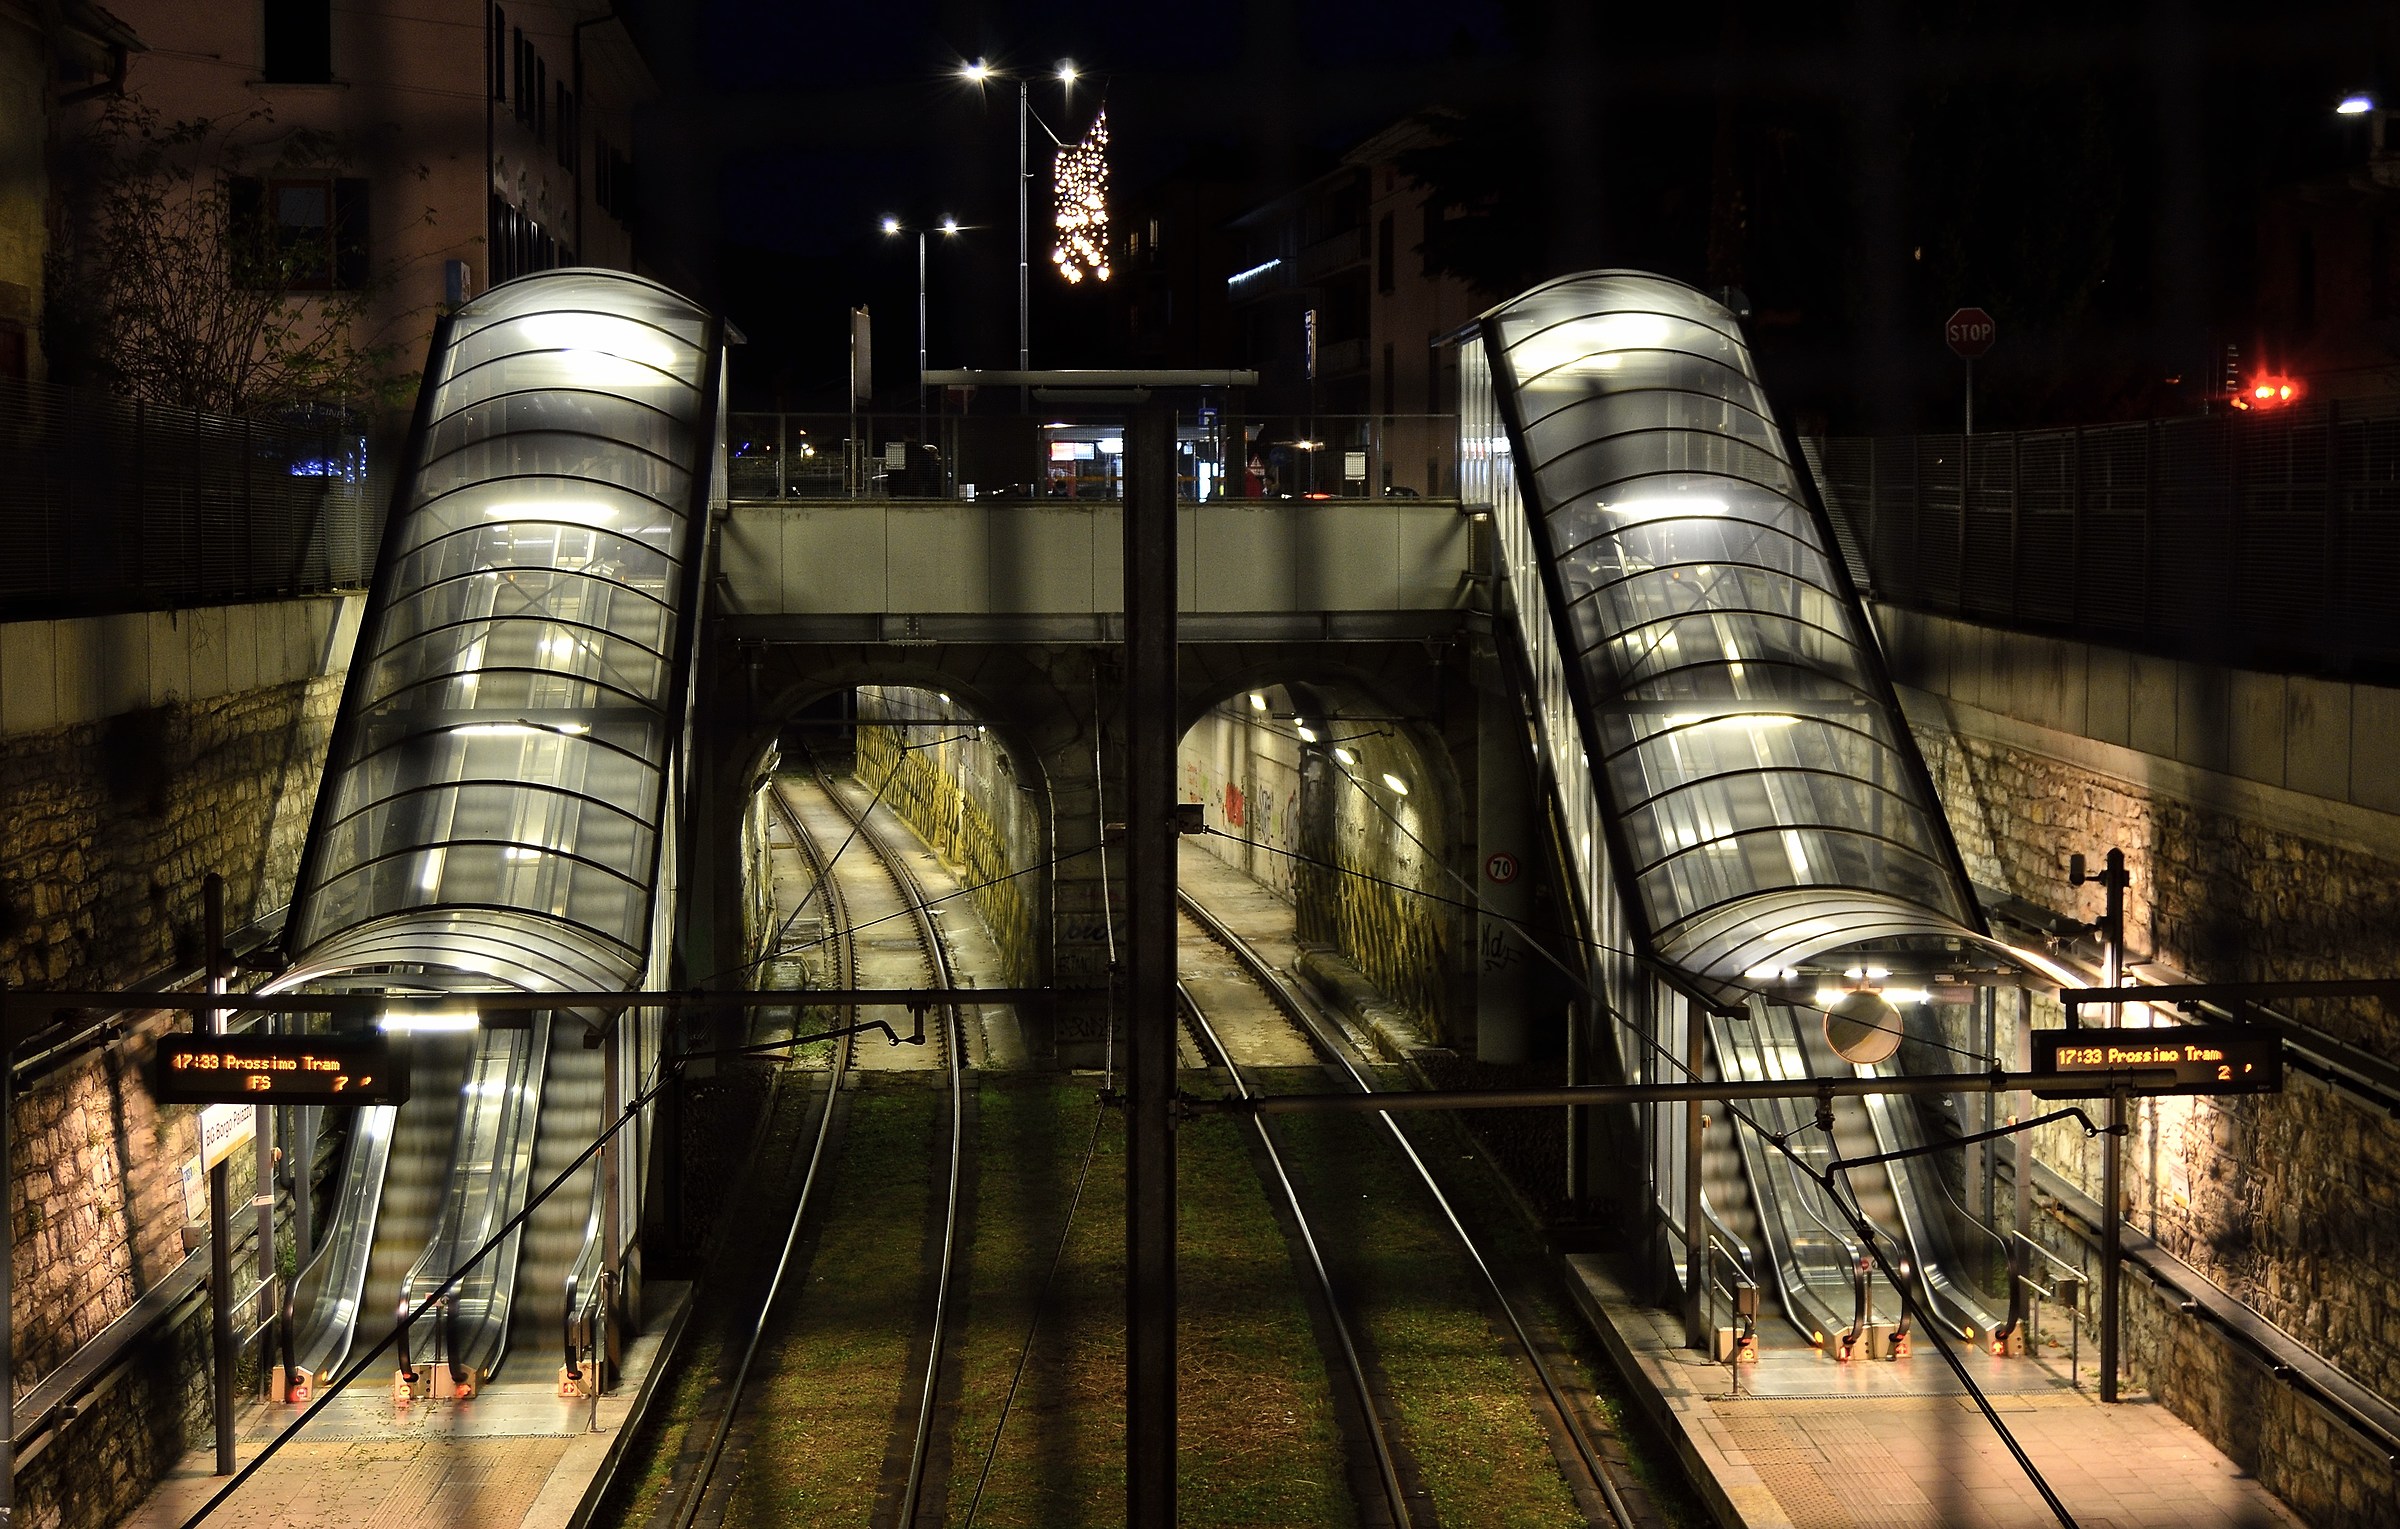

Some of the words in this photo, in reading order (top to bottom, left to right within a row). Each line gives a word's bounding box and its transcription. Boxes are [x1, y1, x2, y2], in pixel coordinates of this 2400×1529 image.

[1950, 324, 1991, 342] STOP
[1493, 860, 1511, 877] 70
[173, 1053, 220, 1070] 17:33
[224, 1055, 297, 1070] Prossimo
[302, 1055, 341, 1071] Tram
[2058, 1049, 2102, 1065] 17:33
[2108, 1046, 2180, 1064] Prossimo
[2184, 1045, 2222, 1061] Tram
[2217, 1065, 2231, 1080] 2
[248, 1075, 272, 1090] FS
[216, 1118, 232, 1138] Borgo
[233, 1104, 253, 1128] Palazzo
